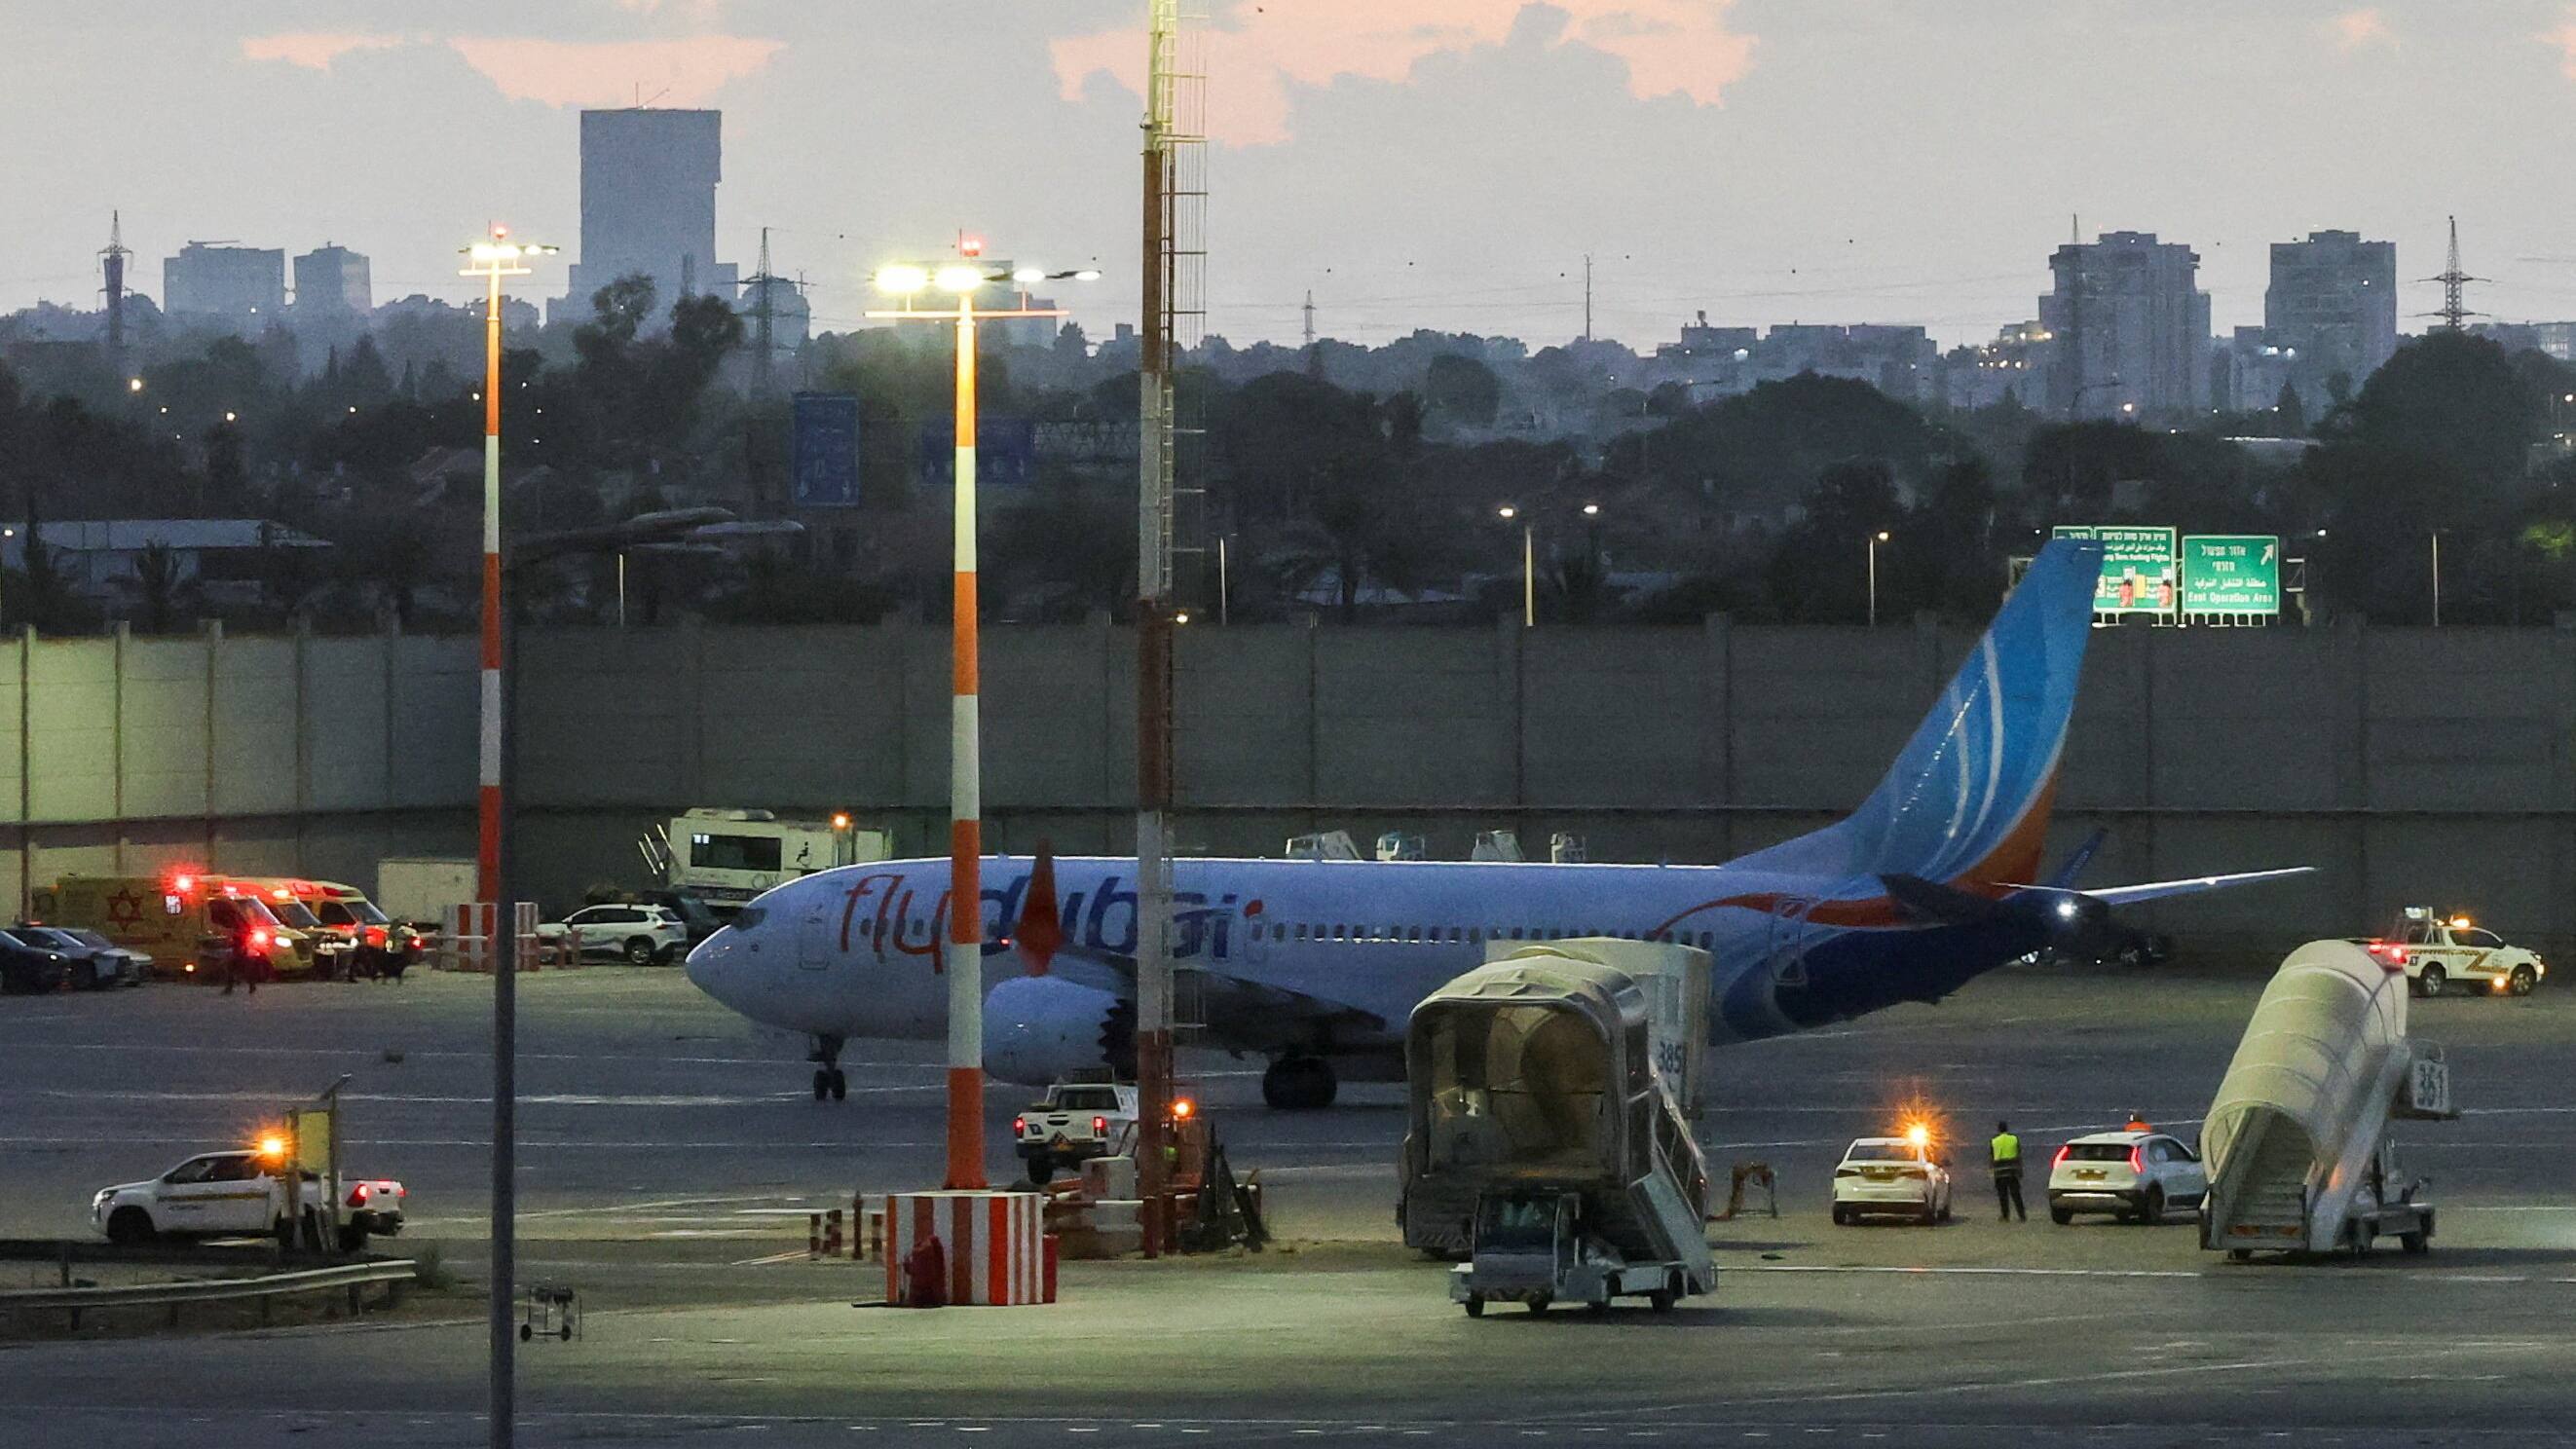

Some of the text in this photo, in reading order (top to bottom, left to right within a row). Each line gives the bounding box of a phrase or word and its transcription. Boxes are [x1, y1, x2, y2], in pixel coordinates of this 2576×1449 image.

[2187, 591, 2273, 605] East Operation Area
